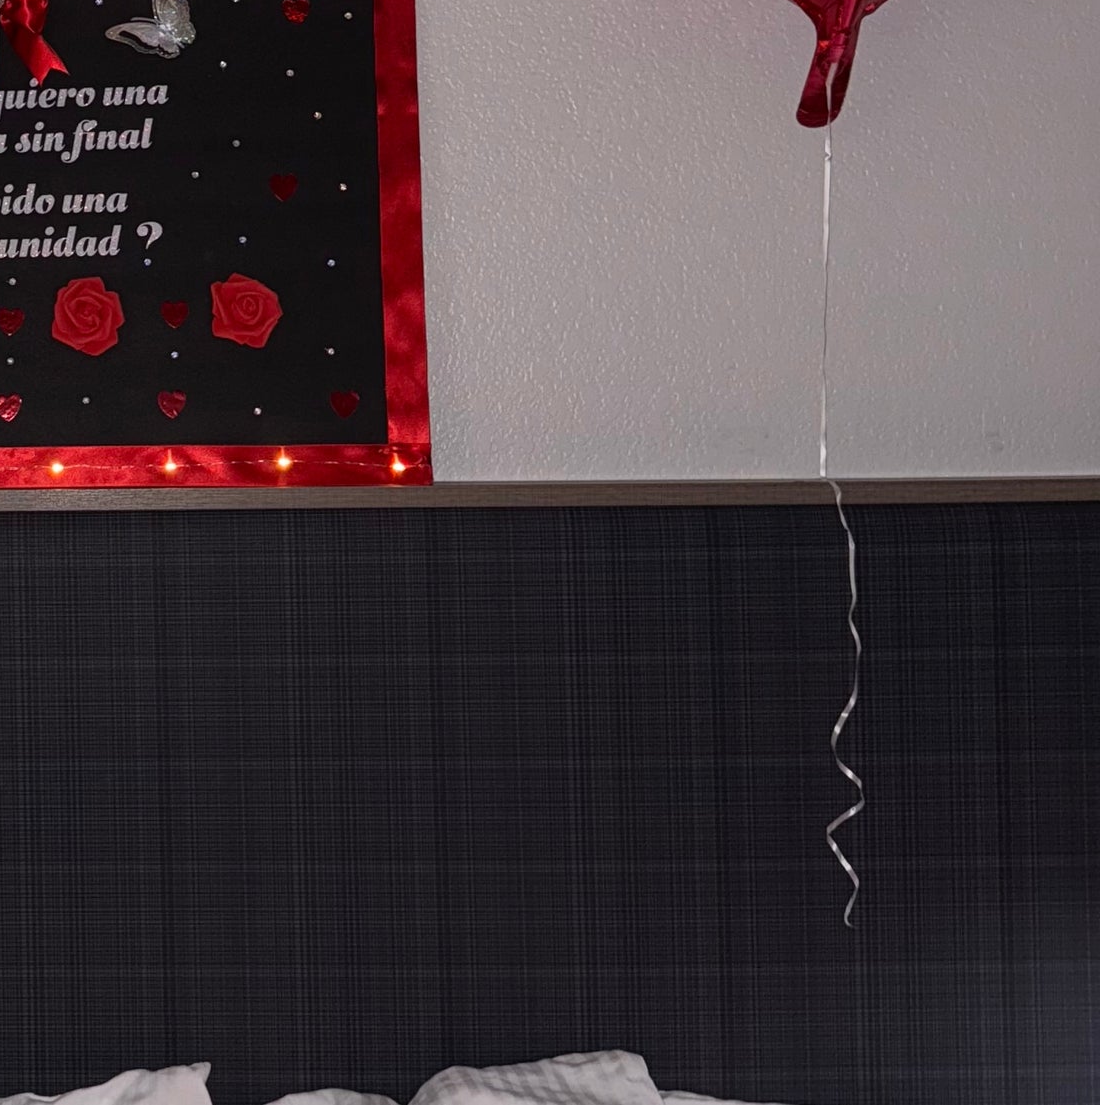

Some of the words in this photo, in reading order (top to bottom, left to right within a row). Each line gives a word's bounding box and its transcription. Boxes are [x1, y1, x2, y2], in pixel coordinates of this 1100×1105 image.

[102, 83, 170, 107] una
[13, 121, 65, 154] sin
[60, 117, 154, 164] final
[61, 190, 129, 214] una
[135, 220, 164, 266] ?
